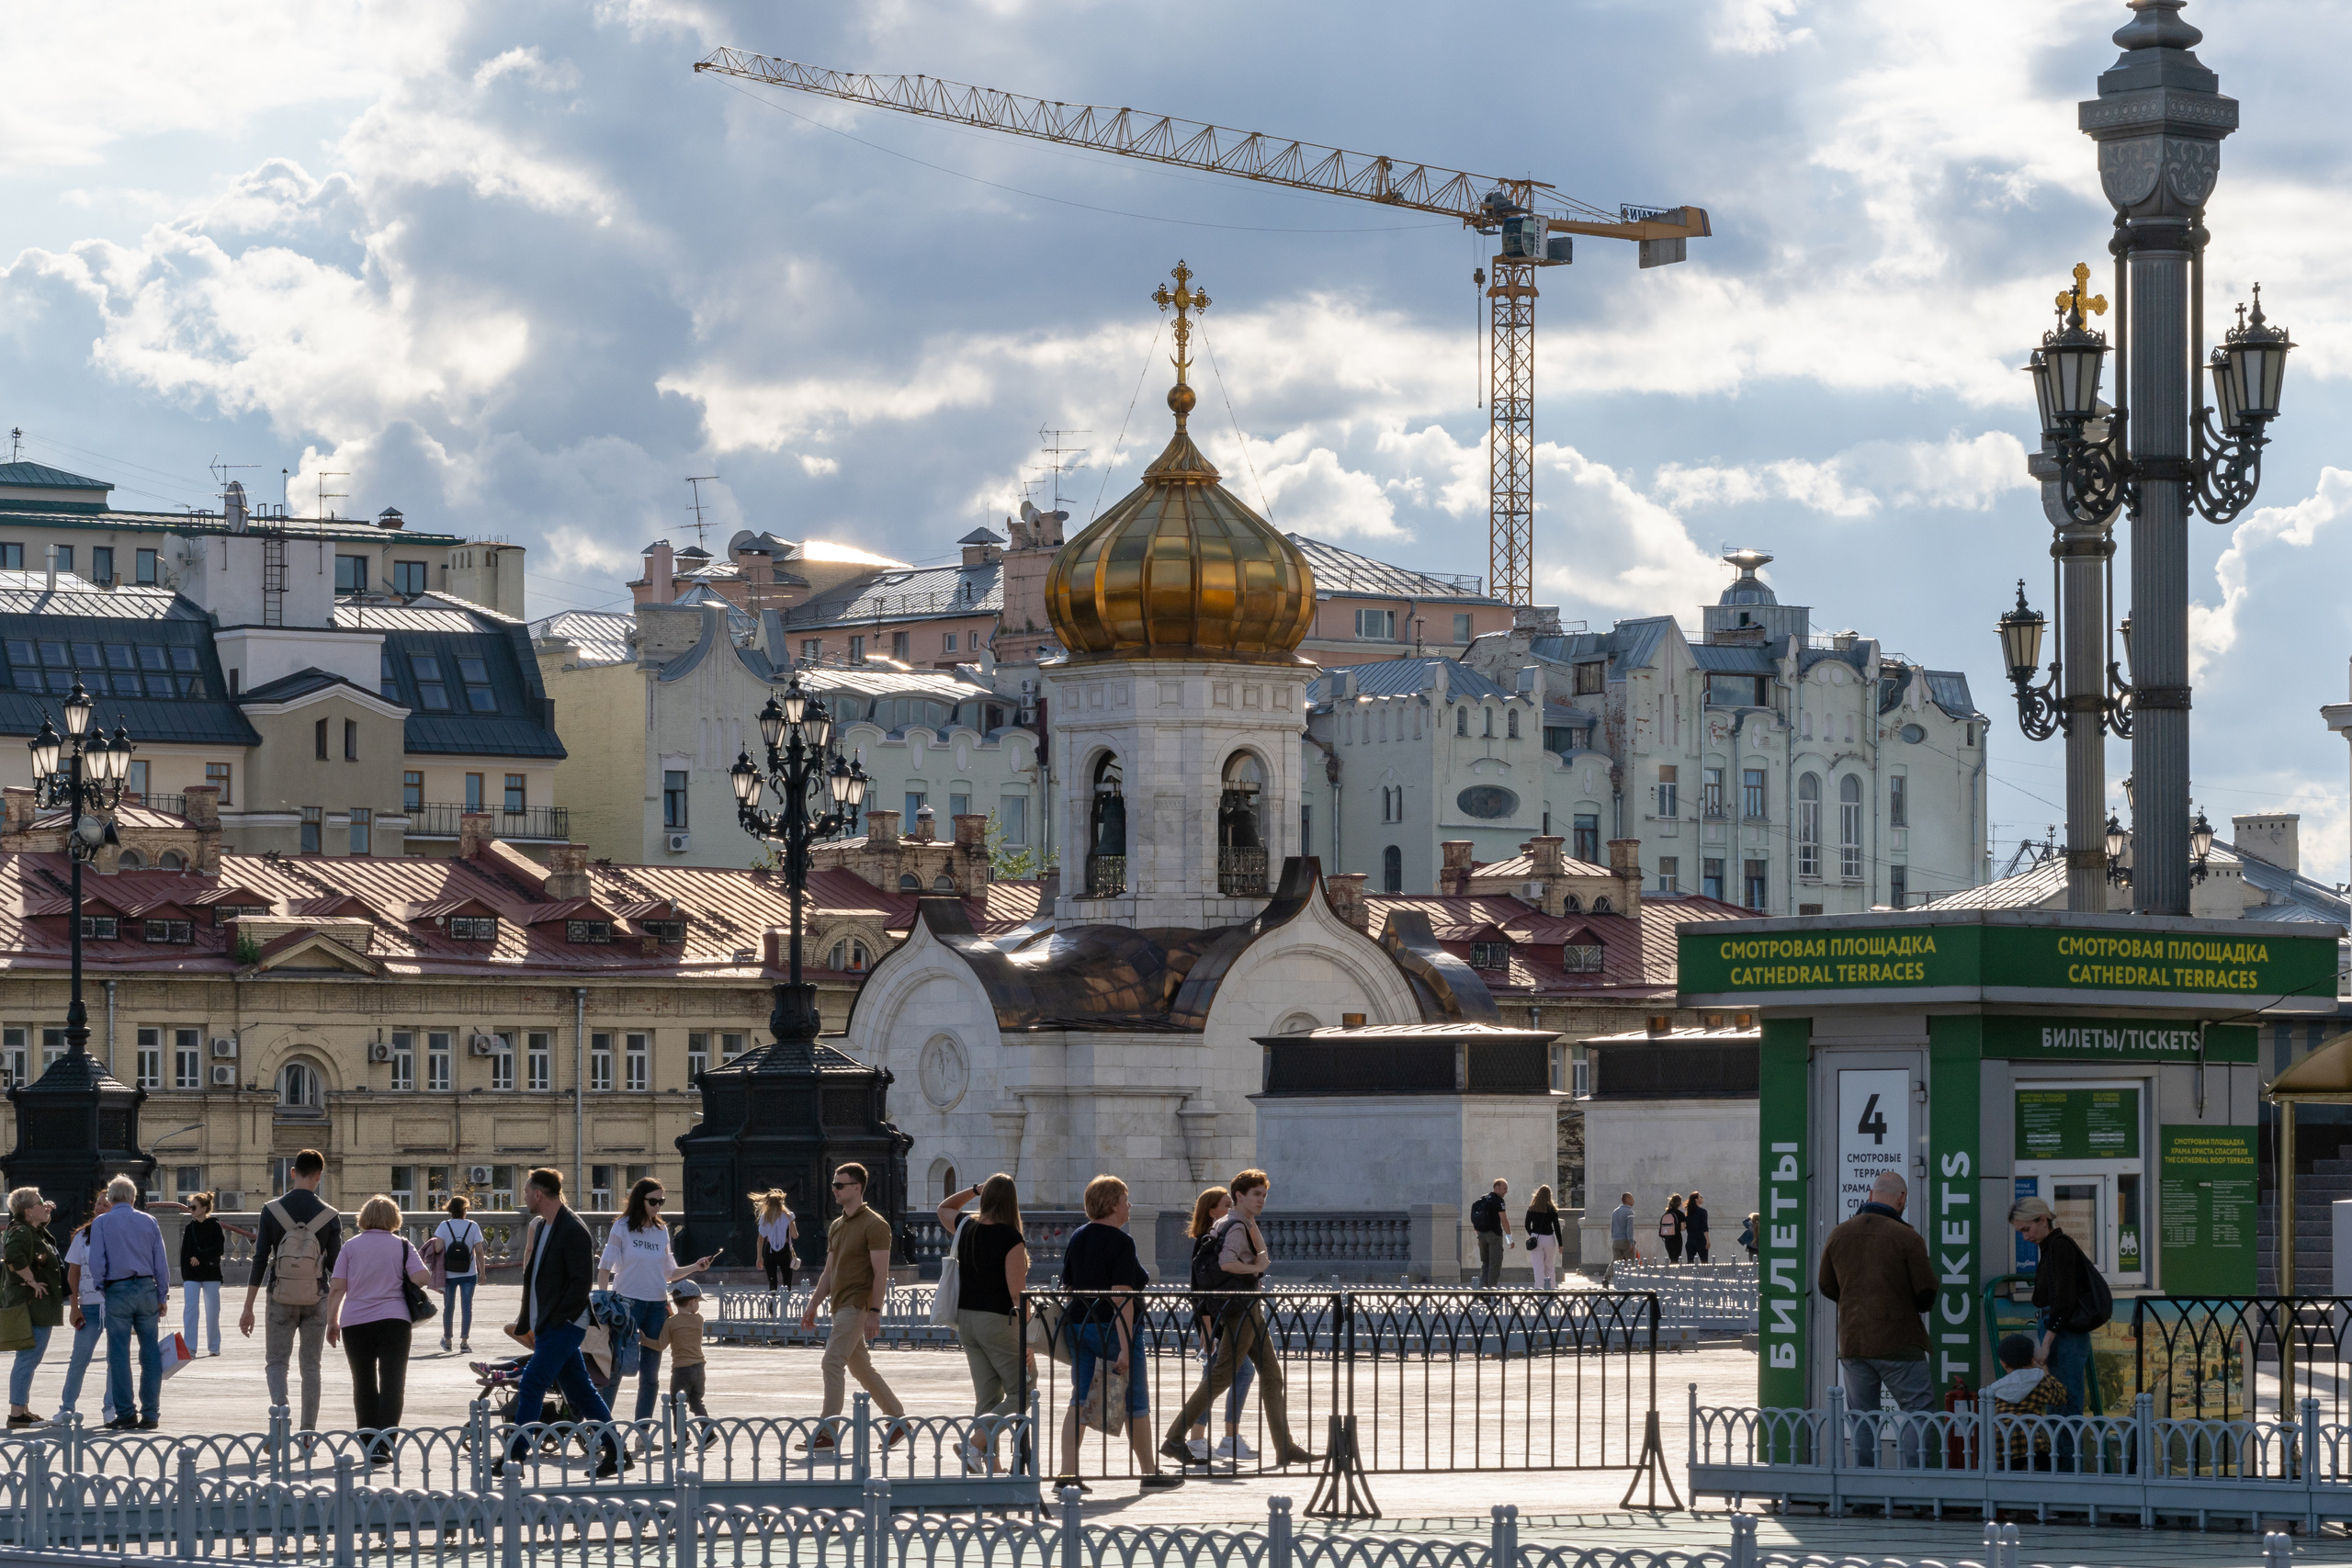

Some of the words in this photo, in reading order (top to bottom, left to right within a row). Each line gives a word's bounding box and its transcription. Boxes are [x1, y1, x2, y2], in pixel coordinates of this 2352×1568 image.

[1720, 939, 1826, 960] СМОТРОВАЯ
[1831, 935, 1937, 957] ПЛОЩАДКА
[2058, 936, 2164, 959] СМОТРОВАЯ
[2168, 941, 2268, 964] ПЛОЩАДКА
[1731, 964, 1834, 985] CATHEDRAL
[1837, 962, 1925, 982] TERRACES
[2068, 964, 2170, 986] CATHEDRAL
[2174, 968, 2257, 989] TERRACES
[2041, 1027, 2200, 1053] БИЛЕТЫ/TICKETS
[1858, 1093, 1887, 1145] 4
[2211, 1138, 2245, 1146] ПЛОЩАДКА
[2215, 1147, 2248, 1156] СПАСИТЕЛЯ
[1847, 1153, 1902, 1163] СМОТРОВЫЕ
[1842, 1184, 1871, 1193] ХРАМА
[632, 1239, 660, 1251] SPIRIT
[1770, 1143, 1798, 1369] БИЛЕТЫ
[1941, 1151, 1970, 1383] TICKETS
